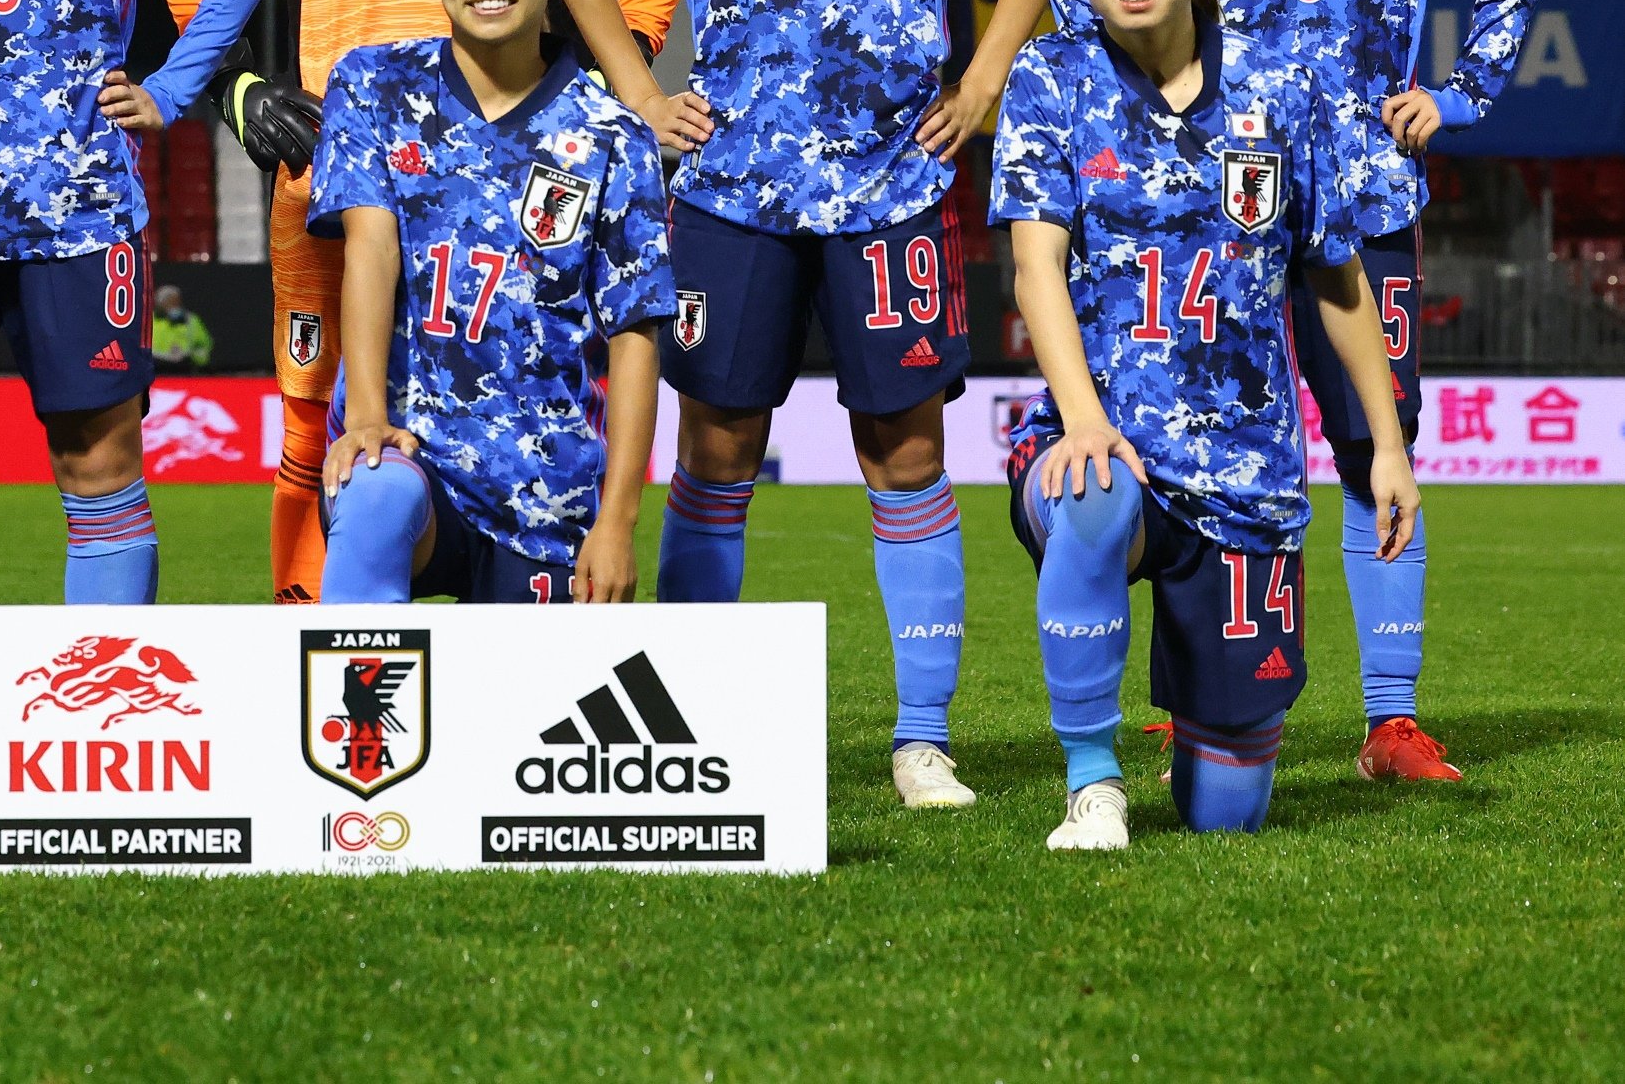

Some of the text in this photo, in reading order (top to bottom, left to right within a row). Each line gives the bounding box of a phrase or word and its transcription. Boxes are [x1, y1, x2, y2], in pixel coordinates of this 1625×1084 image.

[1237, 153, 1266, 164] JAPAN
[546, 172, 578, 187] JAPAN
[104, 239, 136, 329] 8
[423, 242, 507, 343] 17
[863, 236, 941, 329] 19
[1131, 247, 1218, 343] 14
[1382, 277, 1411, 360] 5
[88, 358, 129, 371] adidas
[900, 354, 940, 367] adidas
[1221, 551, 1295, 640] 14
[331, 633, 401, 648] JAPAN
[1041, 617, 1125, 639] JAPAN
[1373, 622, 1425, 635] JAPA
[1255, 667, 1293, 680] adidas
[8, 739, 211, 793] KIRIN
[336, 745, 395, 770] JFA
[515, 744, 731, 795] adidas
[111, 828, 243, 854] PARTNER
[489, 825, 757, 852] OFFICIAL SUPPLIER
[338, 855, 396, 866] 1921-2021
